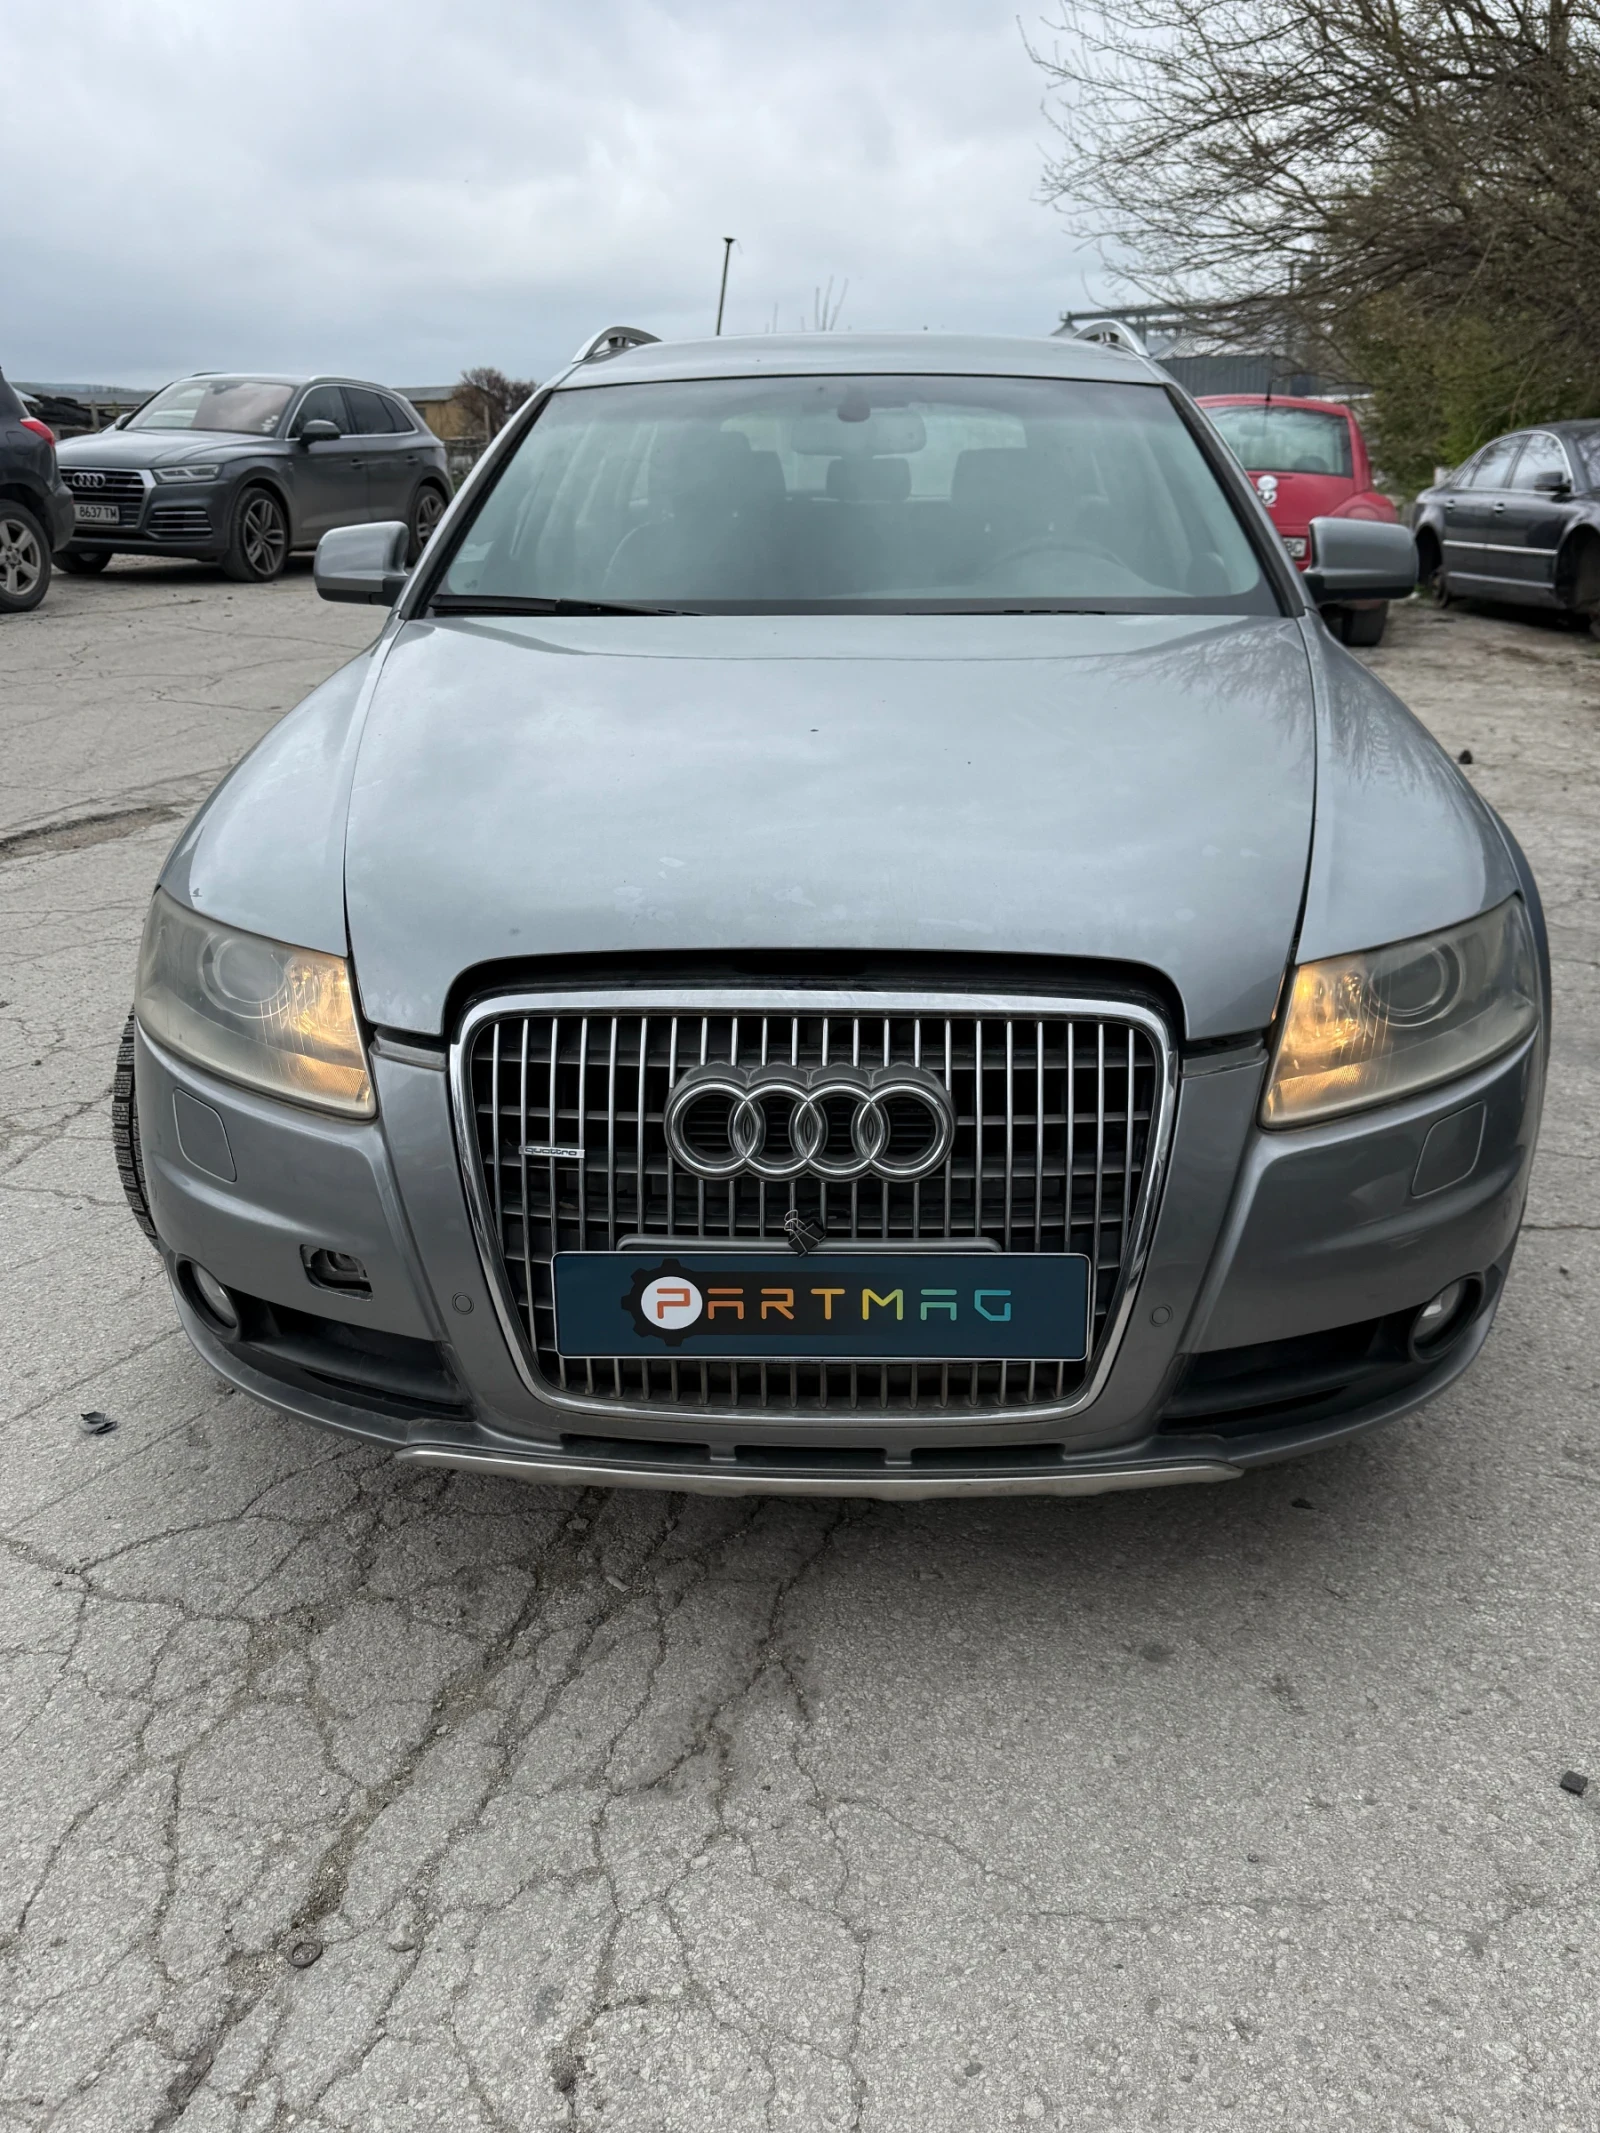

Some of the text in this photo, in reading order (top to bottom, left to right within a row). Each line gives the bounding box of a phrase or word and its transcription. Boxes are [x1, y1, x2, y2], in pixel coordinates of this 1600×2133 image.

[80, 506, 102, 518] 8637
[525, 1147, 577, 1156] quattro
[656, 1287, 1012, 1322] PARTMAG
